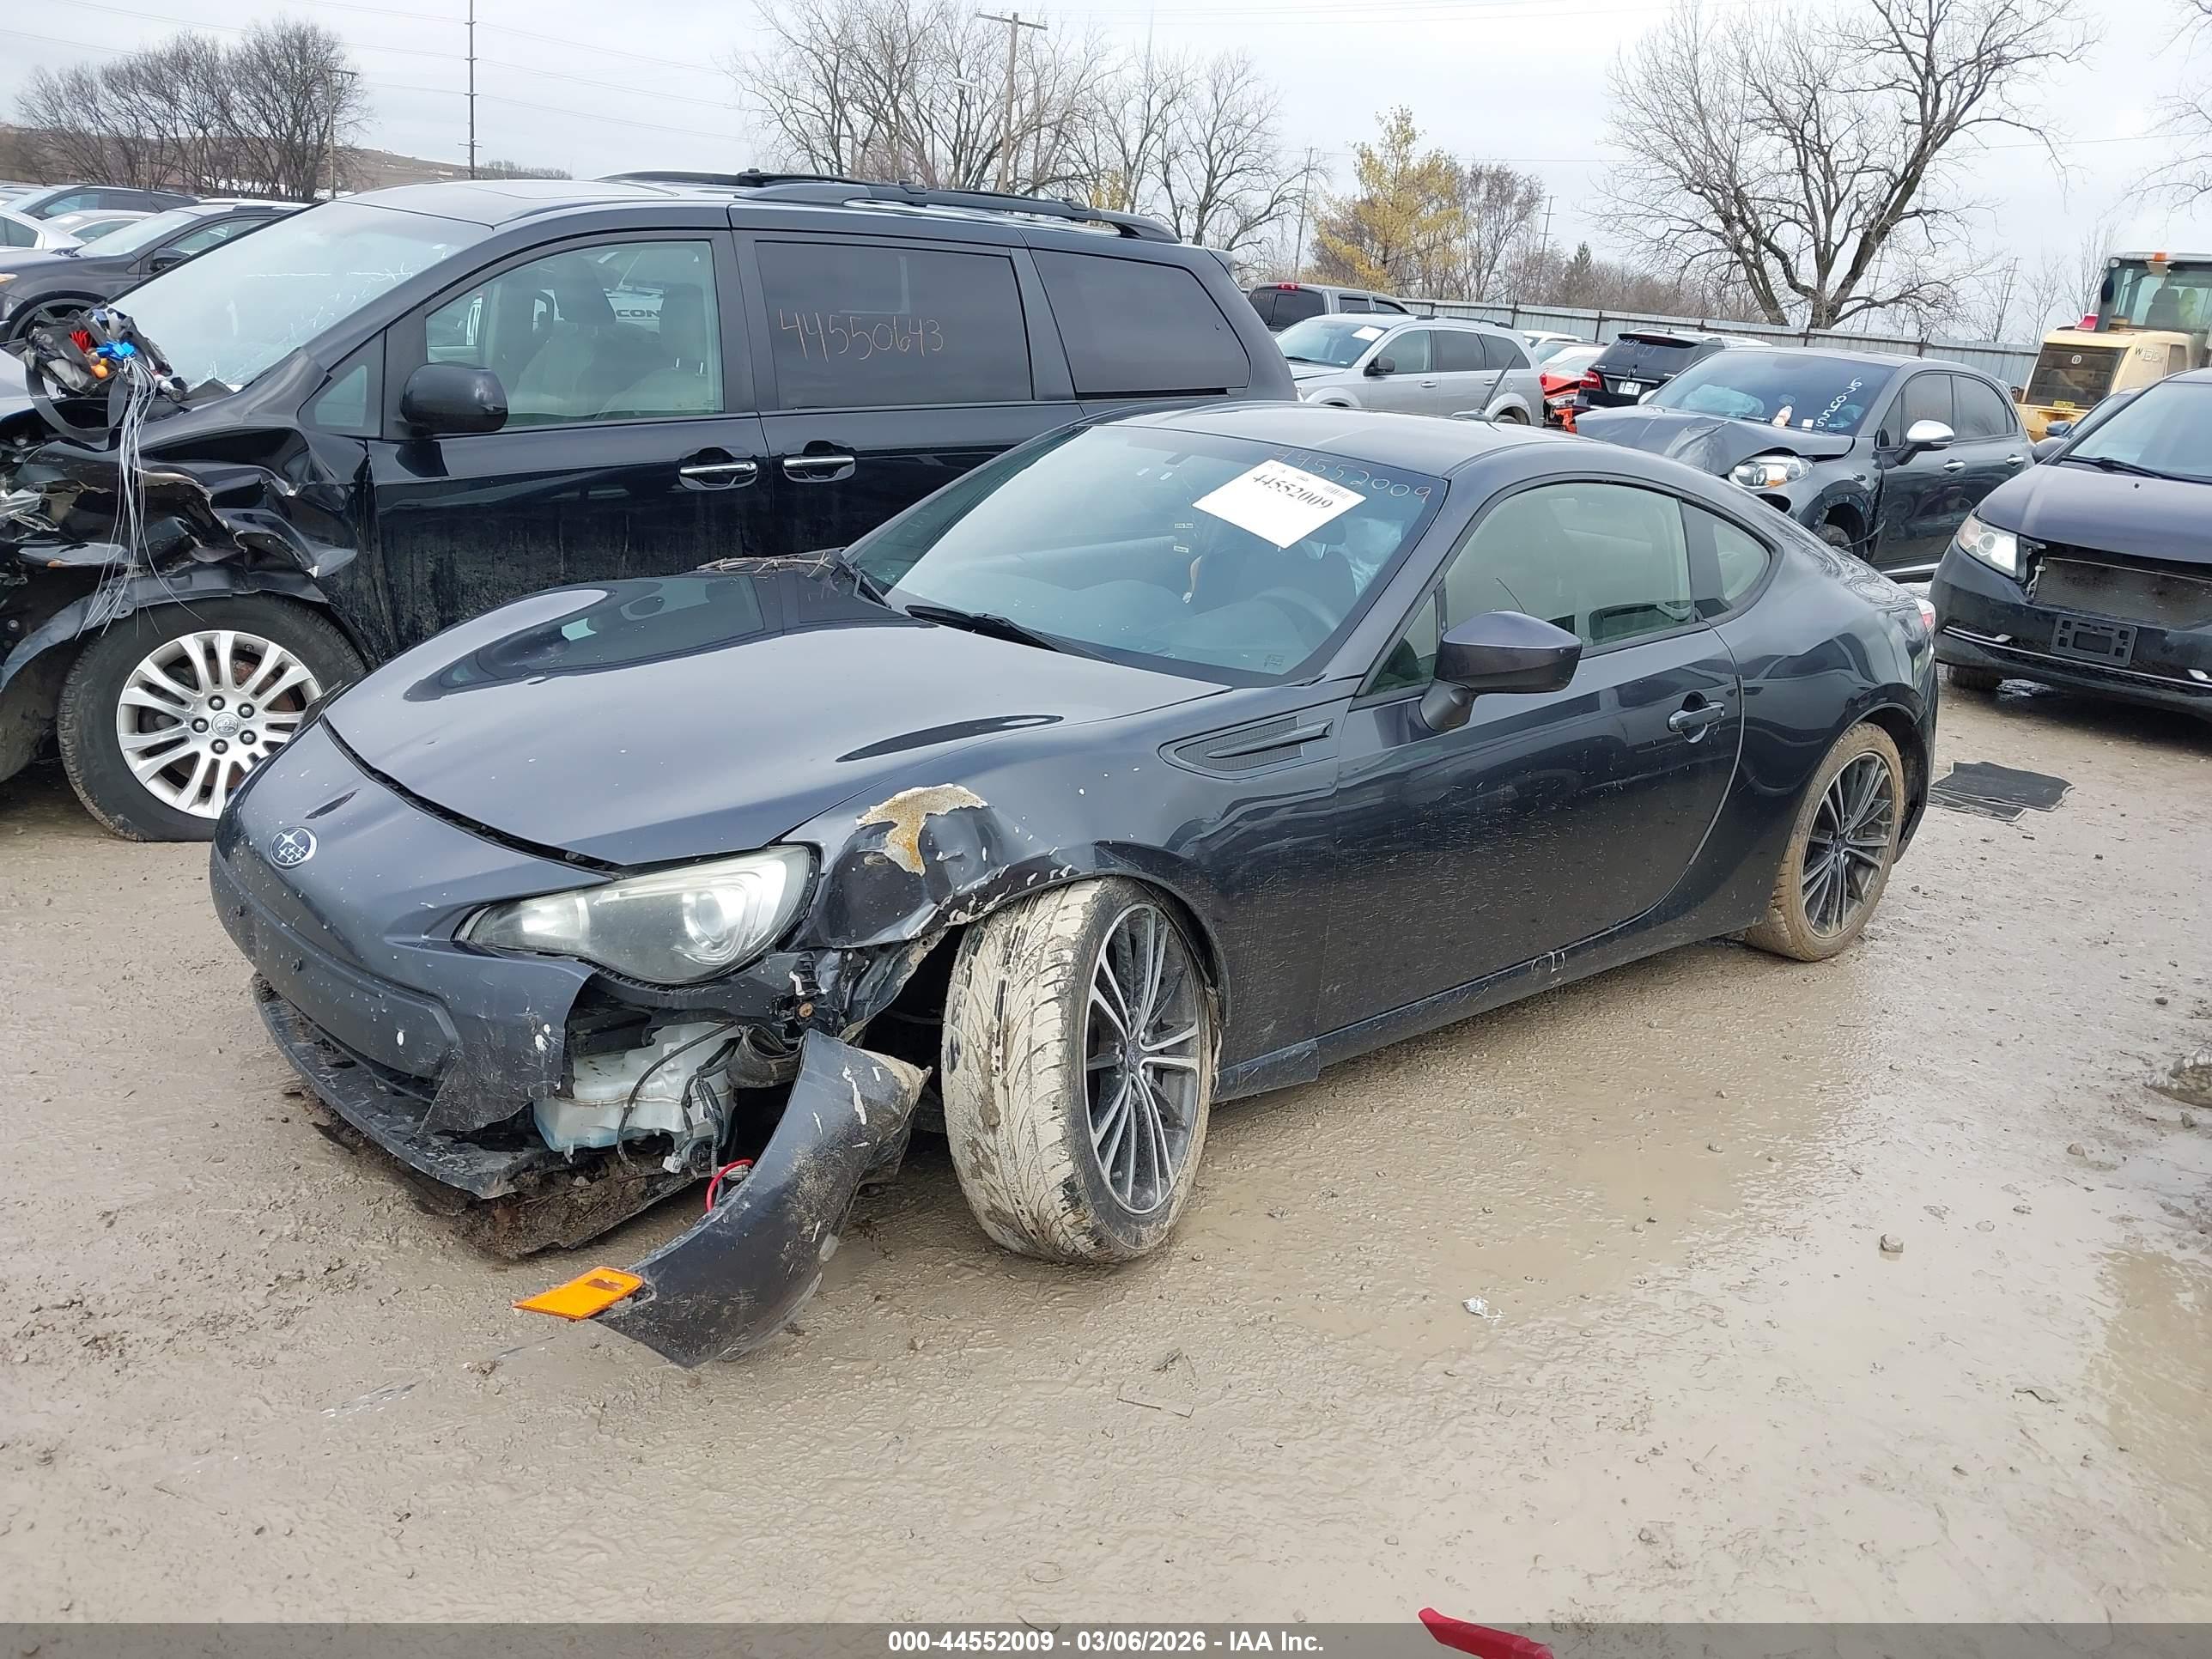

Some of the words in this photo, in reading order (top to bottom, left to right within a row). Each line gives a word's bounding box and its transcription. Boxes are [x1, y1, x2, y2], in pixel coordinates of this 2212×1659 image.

[778, 308, 944, 364] 44550643
[1251, 473, 1334, 510] 44552009
[1272, 445, 1433, 505] 44552009
